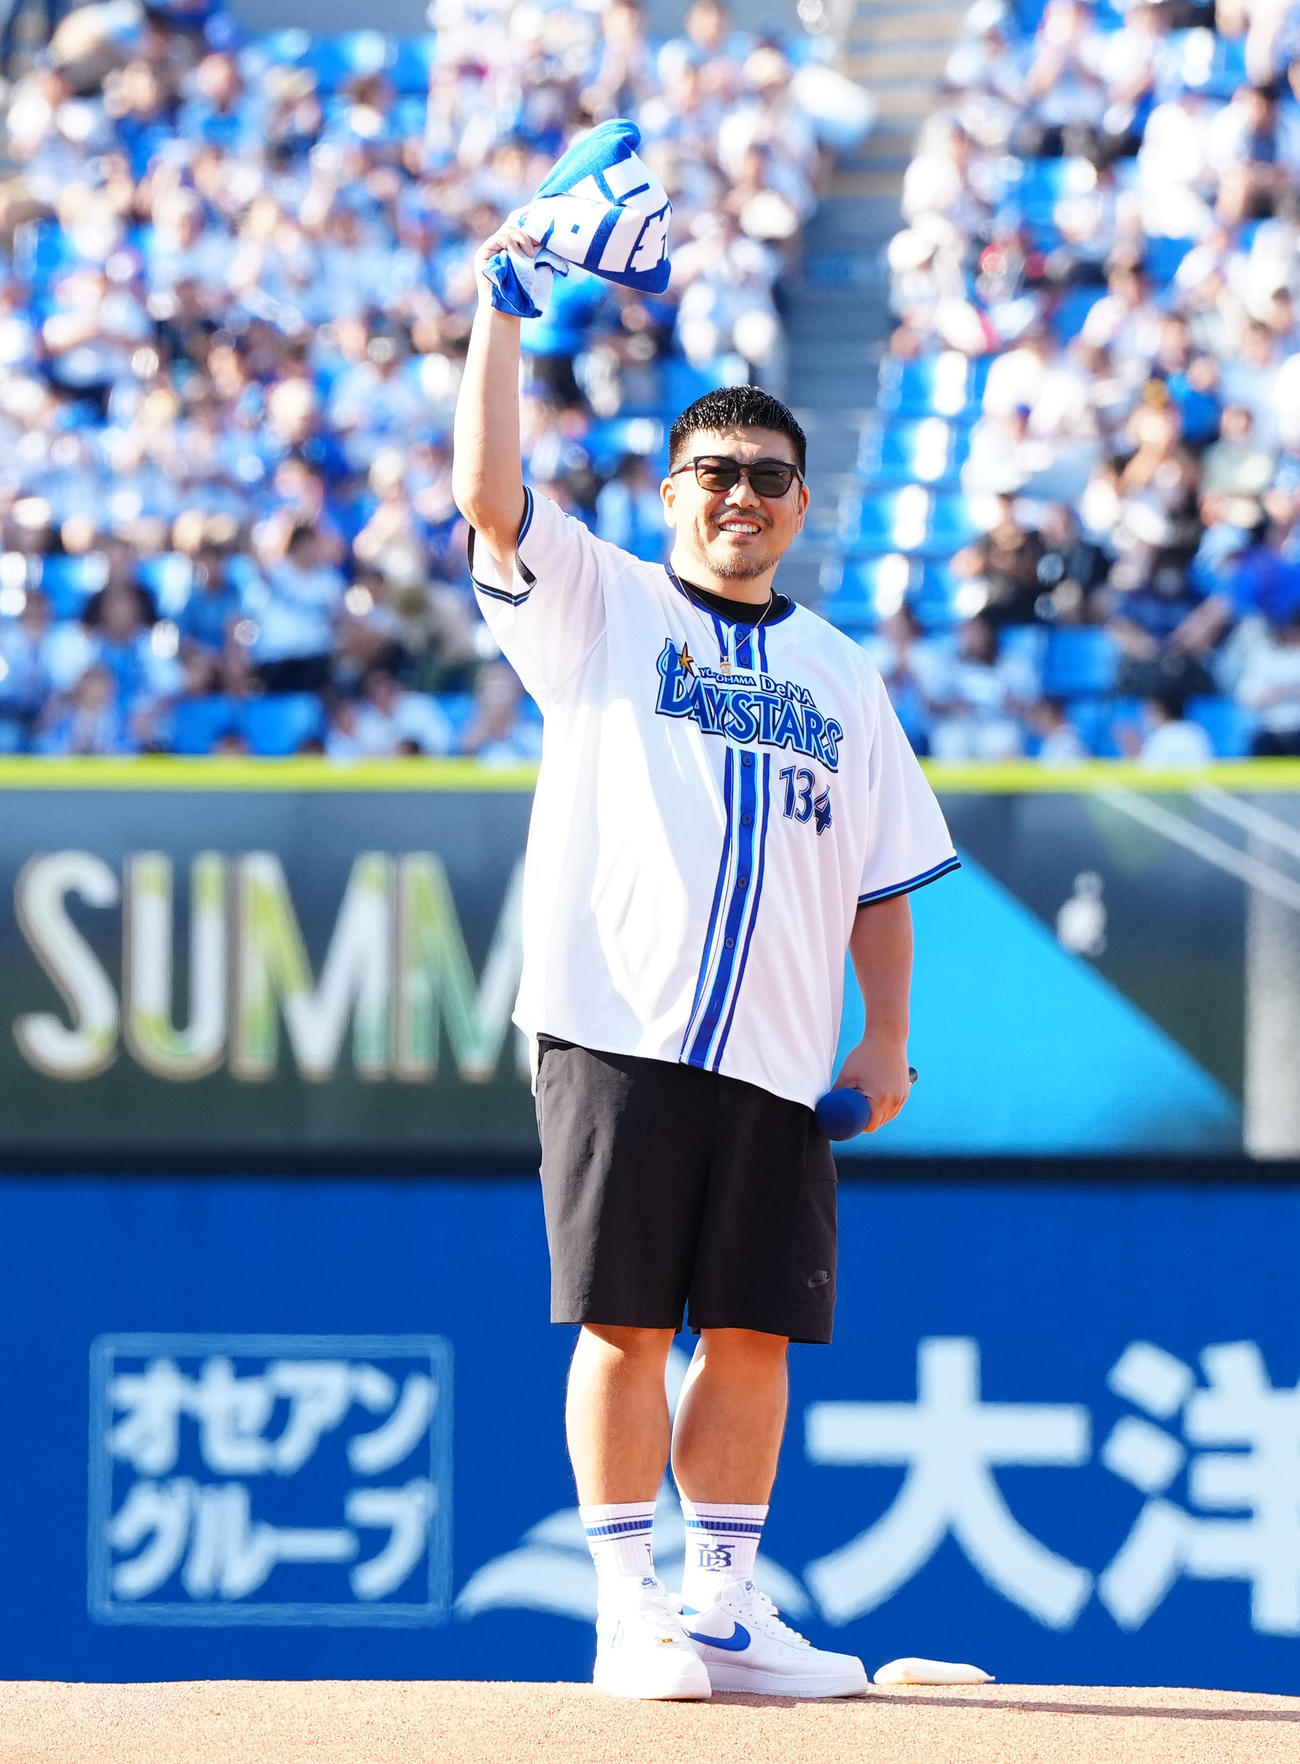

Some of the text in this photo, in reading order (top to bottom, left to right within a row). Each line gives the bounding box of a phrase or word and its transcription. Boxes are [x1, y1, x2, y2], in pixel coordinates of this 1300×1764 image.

[655, 637, 843, 773] BAYSTARS
[698, 667, 816, 708] YOOHAMA DeNA
[779, 766, 832, 835] 134
[106, 1355, 437, 1476] オセアン
[105, 1475, 438, 1601] グループ
